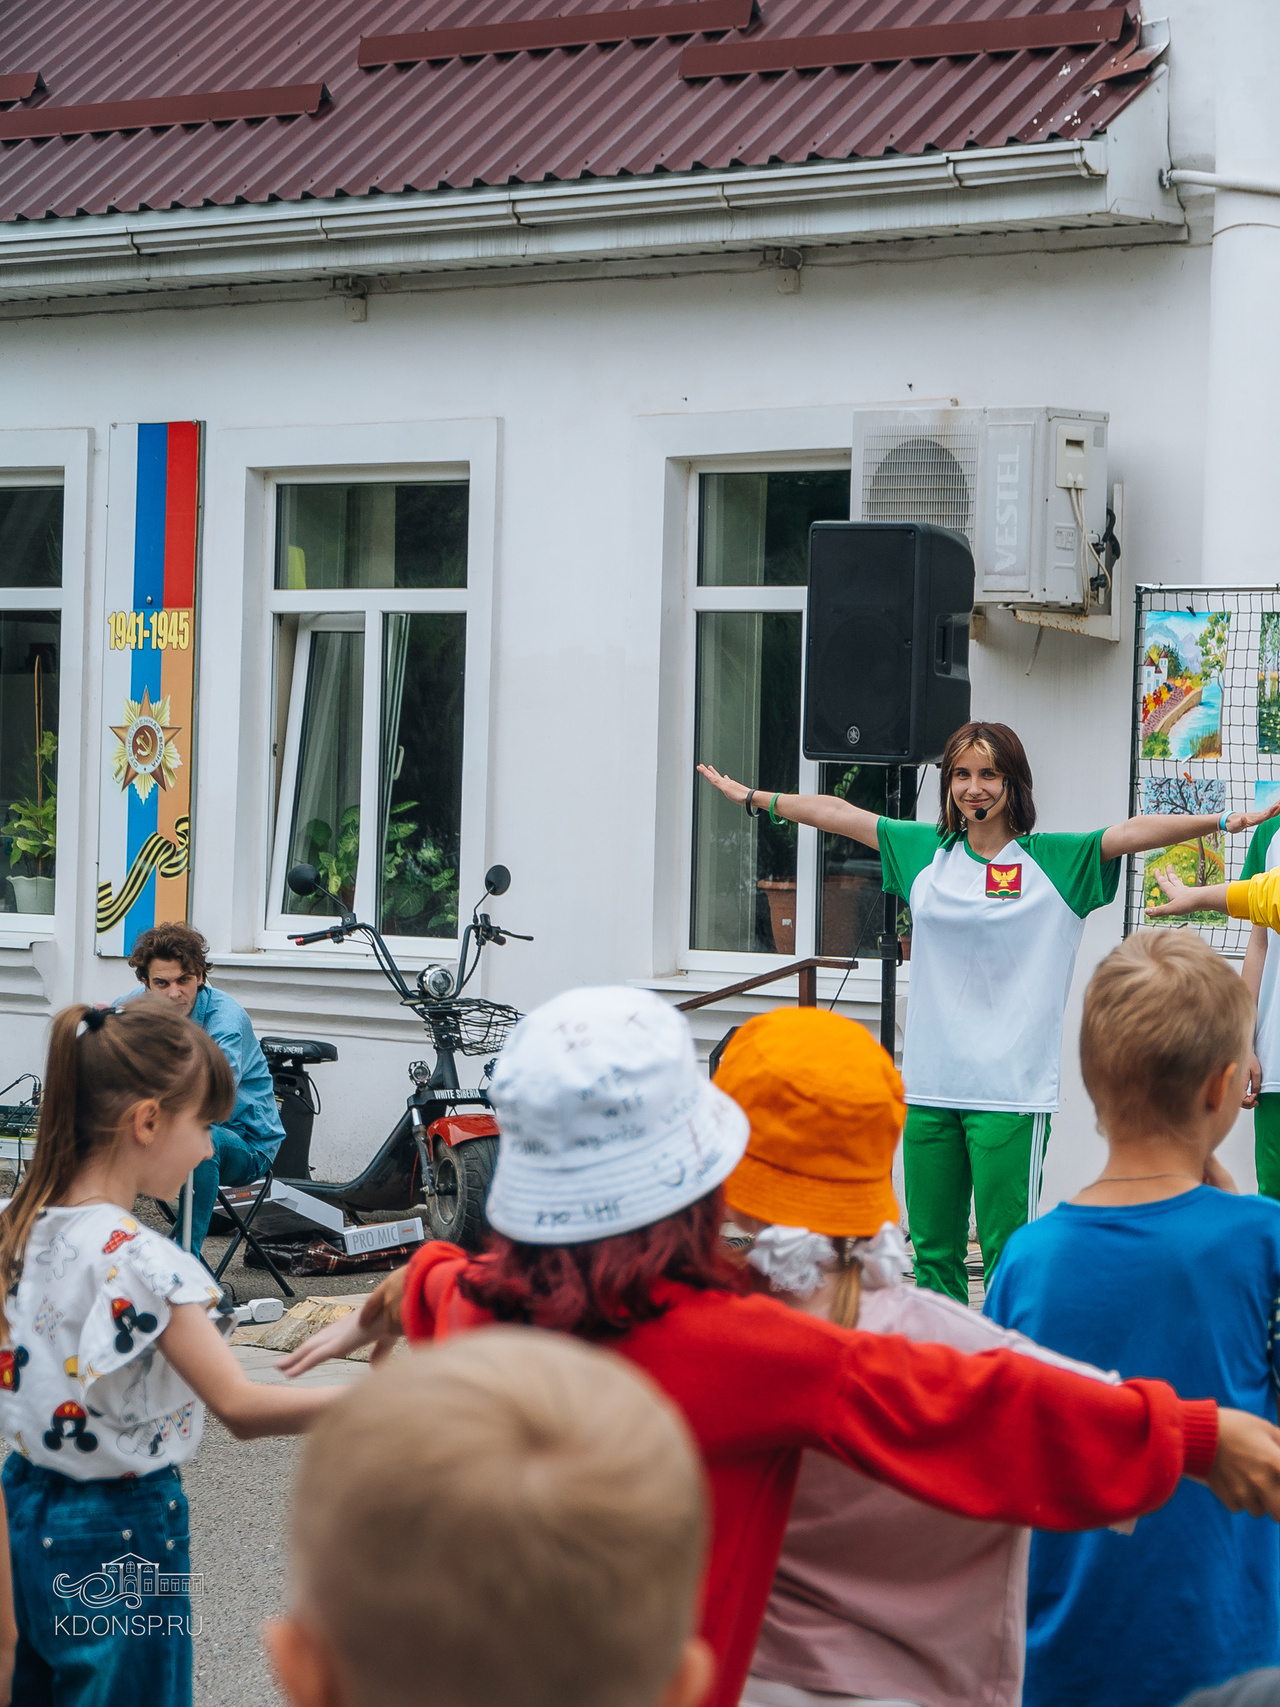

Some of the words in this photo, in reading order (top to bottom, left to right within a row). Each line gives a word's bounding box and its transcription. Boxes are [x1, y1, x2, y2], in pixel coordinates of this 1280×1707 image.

[994, 444, 1020, 573] VESTEL
[107, 610, 190, 650] 1941-1945
[434, 1089, 455, 1100] WHITE
[456, 1089, 481, 1099] SIBERIA
[352, 1231, 375, 1251] PRO
[377, 1225, 398, 1245] MIC
